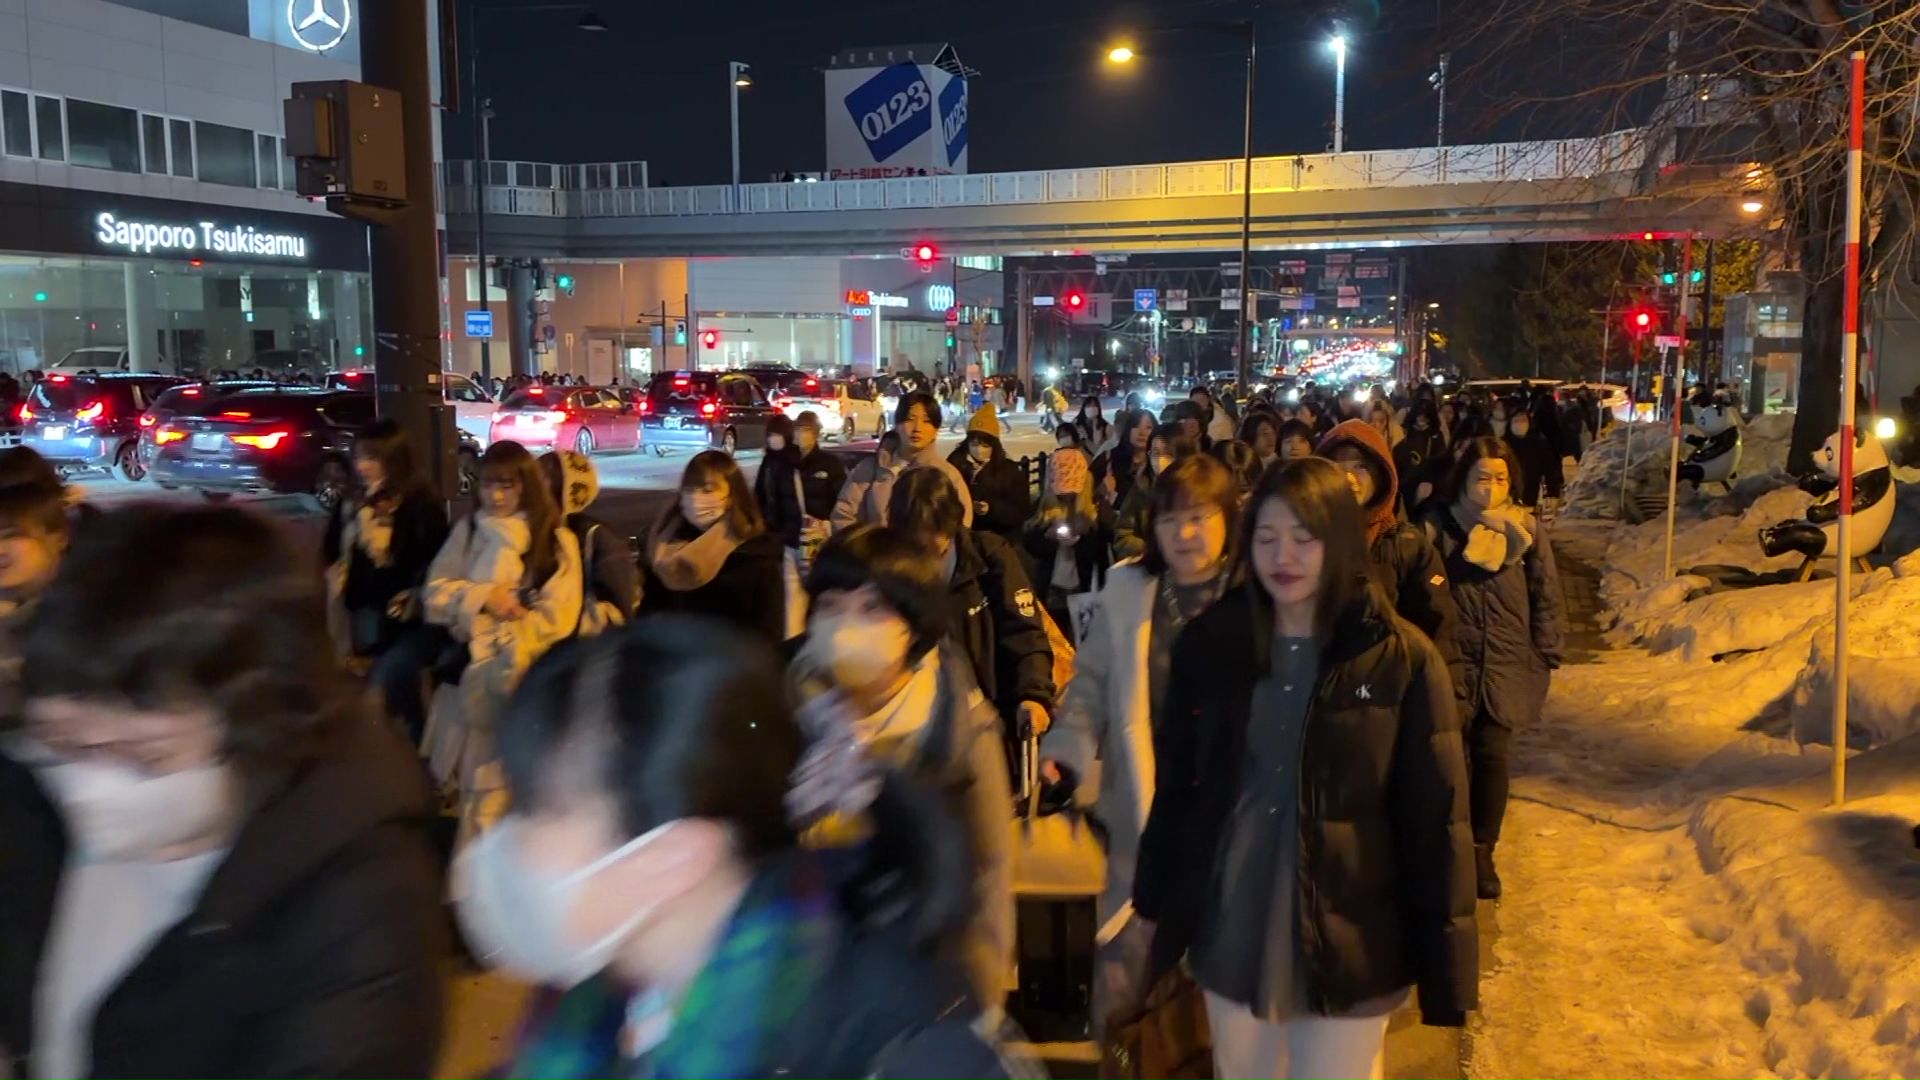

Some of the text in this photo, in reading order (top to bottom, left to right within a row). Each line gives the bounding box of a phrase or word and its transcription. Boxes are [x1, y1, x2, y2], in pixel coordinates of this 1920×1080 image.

[860, 80, 932, 141] 0123
[943, 95, 968, 146] 0123
[99, 212, 305, 257] Sapporo Tsukisamu
